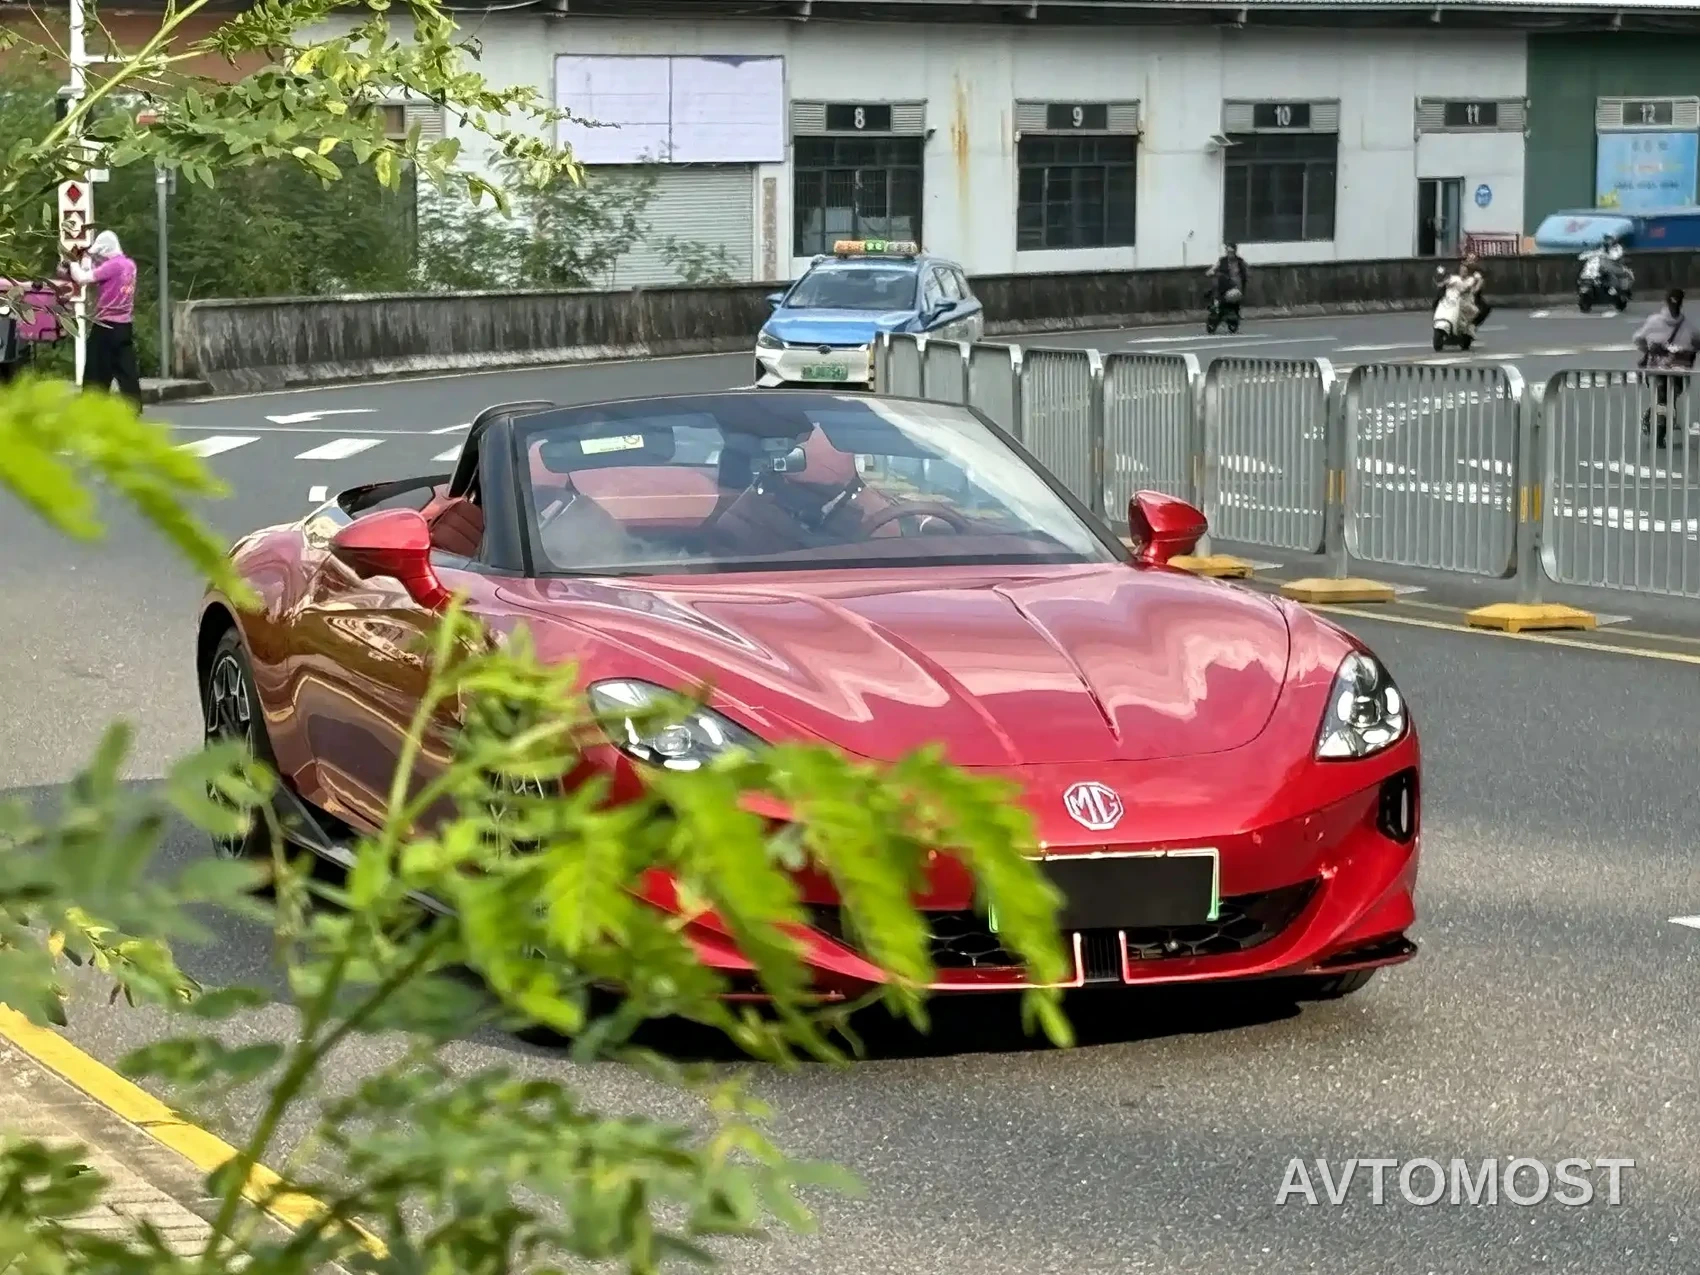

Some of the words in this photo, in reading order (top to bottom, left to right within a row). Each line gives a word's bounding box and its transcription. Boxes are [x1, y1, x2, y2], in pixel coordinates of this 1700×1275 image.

[854, 106, 865, 129] 8
[1072, 105, 1083, 128] 9
[1273, 104, 1291, 126] 10
[1465, 103, 1480, 125] 11
[1639, 103, 1656, 125] 12
[1067, 785, 1121, 826] MG
